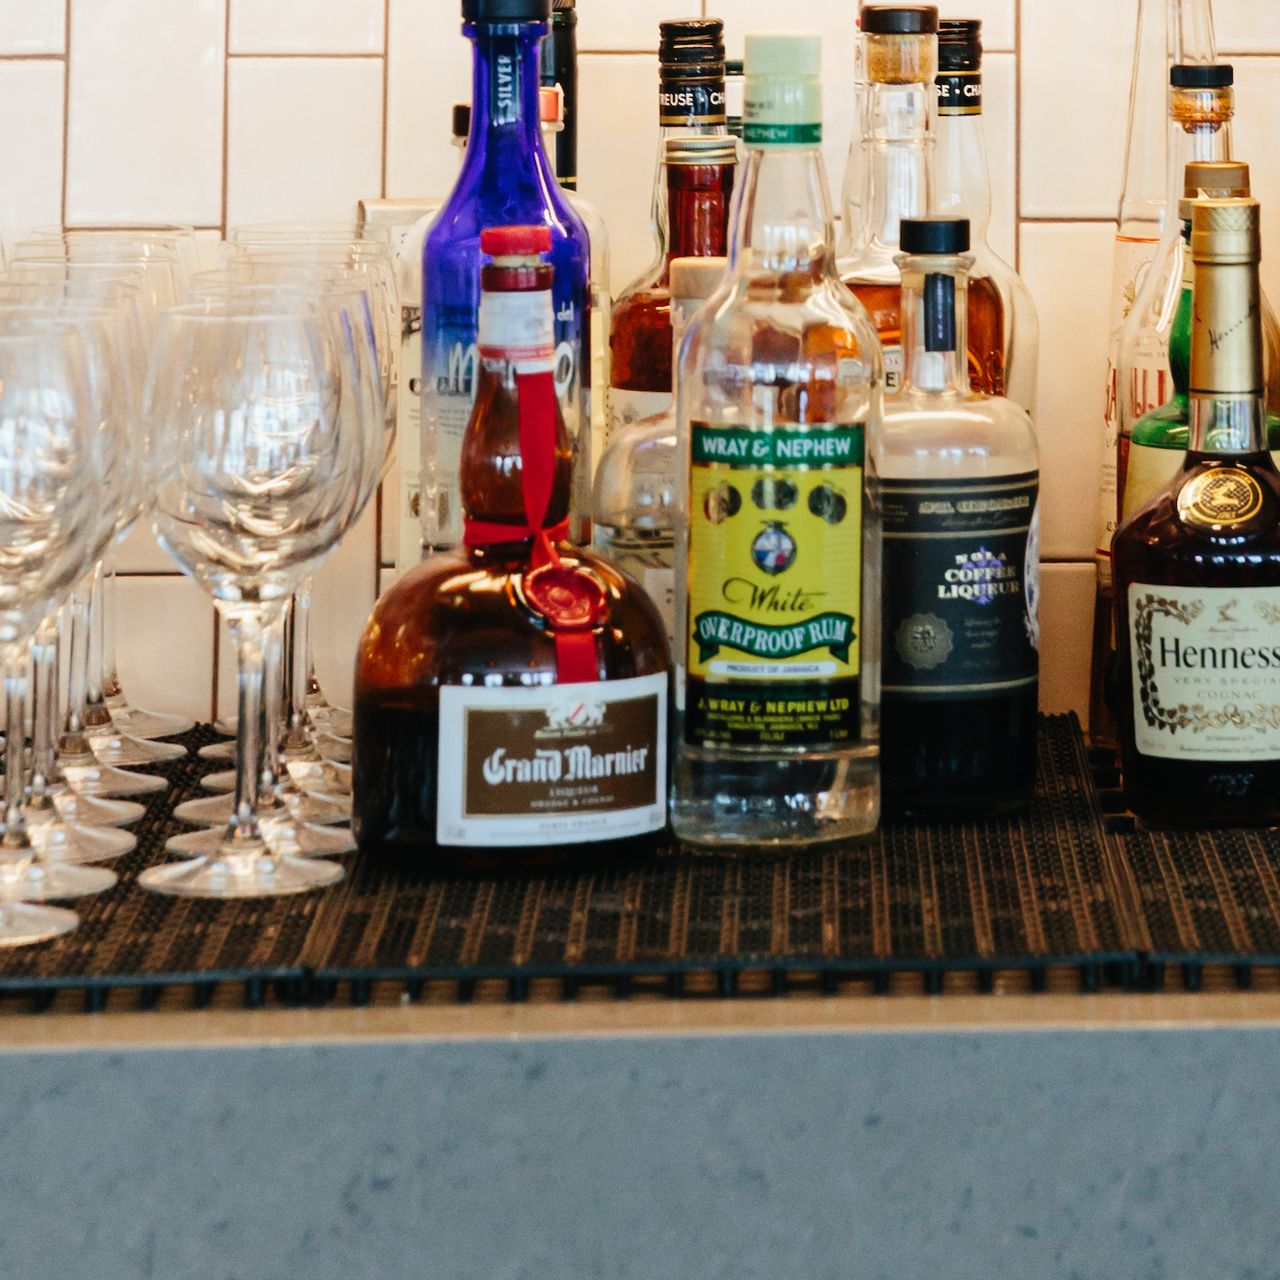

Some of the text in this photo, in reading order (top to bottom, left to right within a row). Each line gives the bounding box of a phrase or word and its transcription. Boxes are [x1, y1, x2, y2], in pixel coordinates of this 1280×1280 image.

[496, 54, 514, 109] SILVER
[659, 92, 694, 106] REUSE
[702, 436, 851, 458] WRAY & NEPHEW
[955, 551, 1007, 565] NOLA
[944, 566, 1016, 583] COFFEE
[721, 577, 828, 612] White
[937, 580, 1020, 600] LIQUEUR
[699, 617, 848, 653] OVERPROOF RUM
[1172, 676, 1212, 686] VERY
[1196, 690, 1261, 700] COGNAC
[707, 697, 850, 714] WRAY & NEPHEW LTD
[482, 743, 649, 785] Grand Marnier
